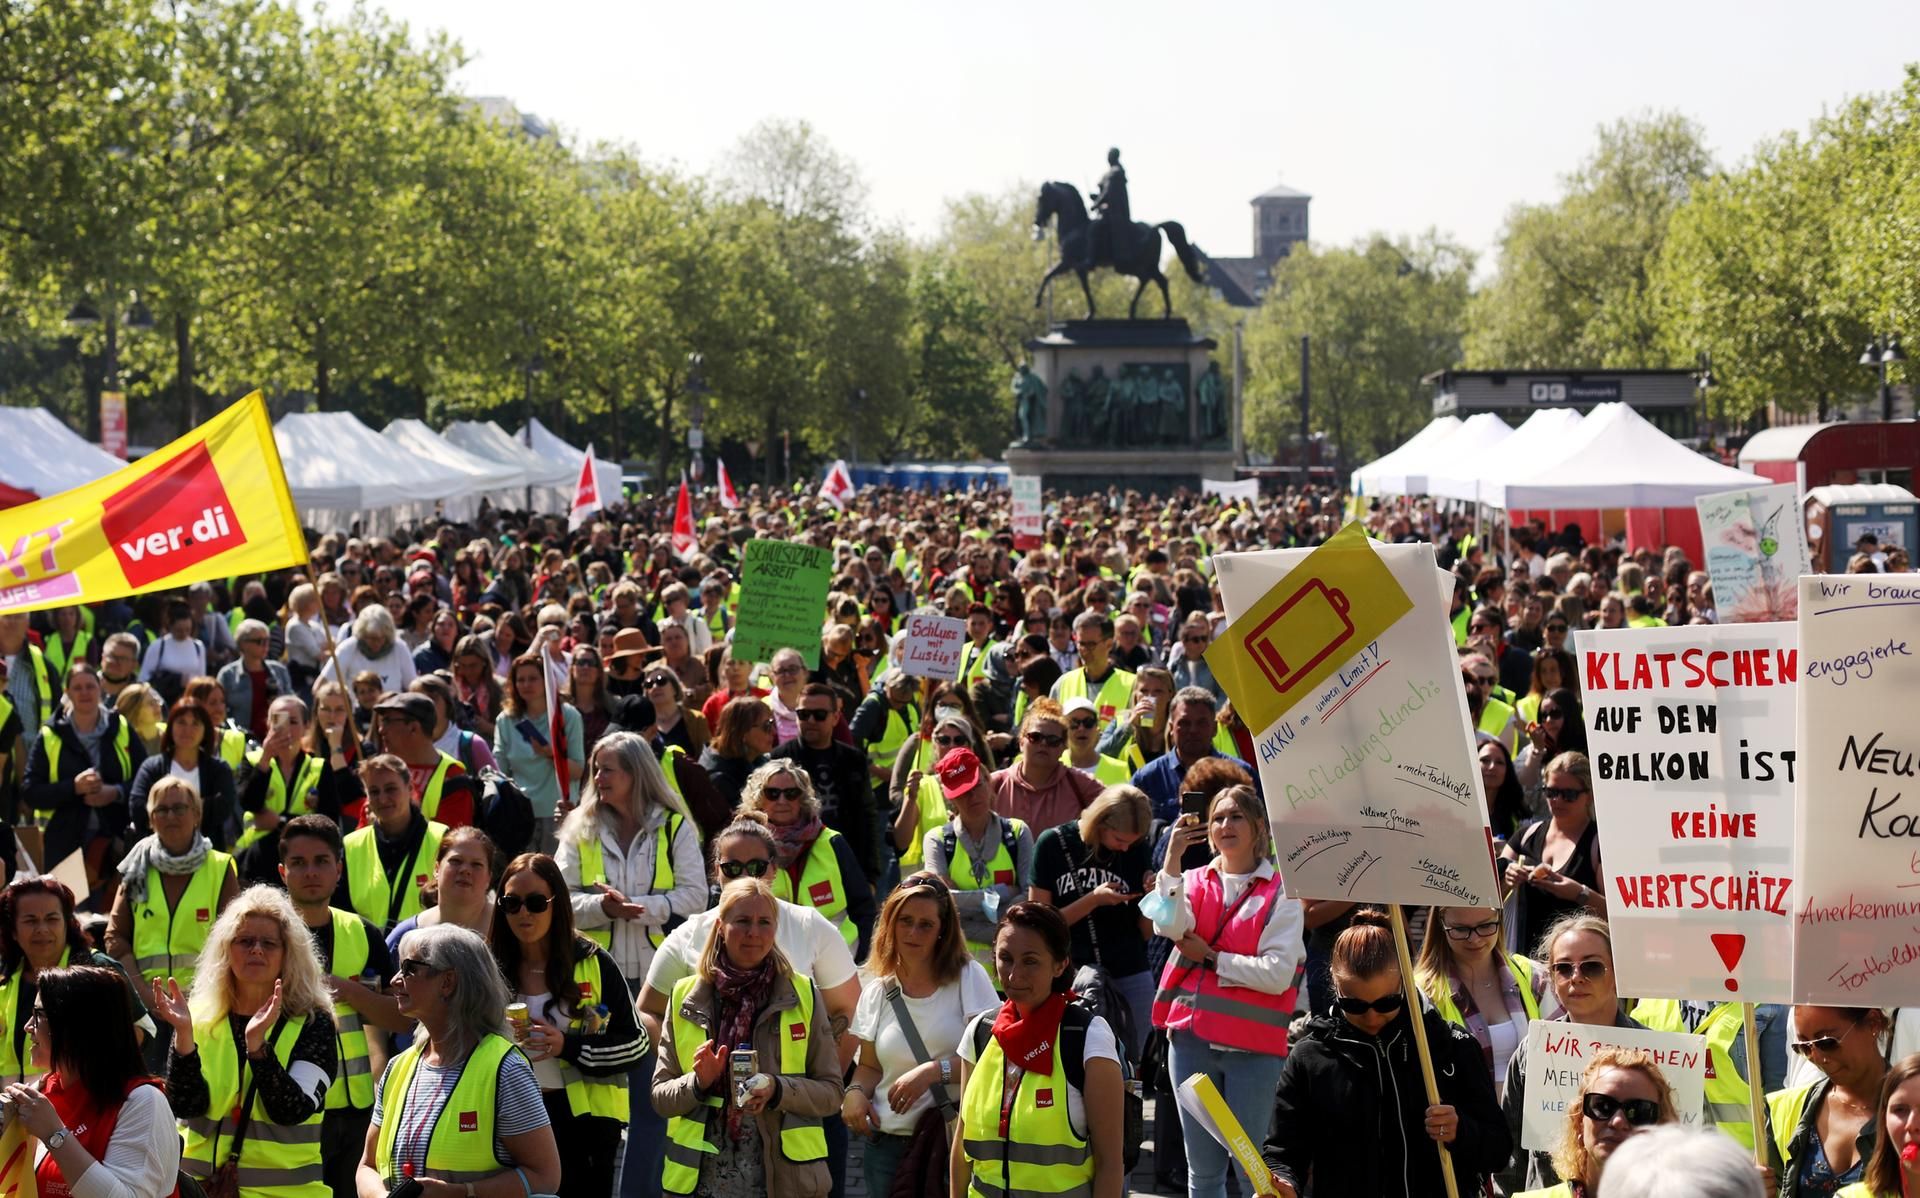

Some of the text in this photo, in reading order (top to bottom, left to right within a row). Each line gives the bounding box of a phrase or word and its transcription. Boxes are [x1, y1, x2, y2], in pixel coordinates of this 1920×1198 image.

[120, 505, 230, 562] ver.di
[1820, 582, 1851, 598] Wir
[1586, 648, 1798, 691] KLATSCHEN
[1806, 639, 1912, 686] engagierte
[1594, 704, 1717, 734] AUF DEN
[1260, 721, 1295, 764] AKKU
[1838, 732, 1920, 778] NEU
[1598, 750, 1709, 782] BALKON
[1426, 874, 1480, 906] Ausbildung
[1615, 870, 1793, 917] WERTSCHÄTZ
[1023, 1040, 1050, 1061] ver.di
